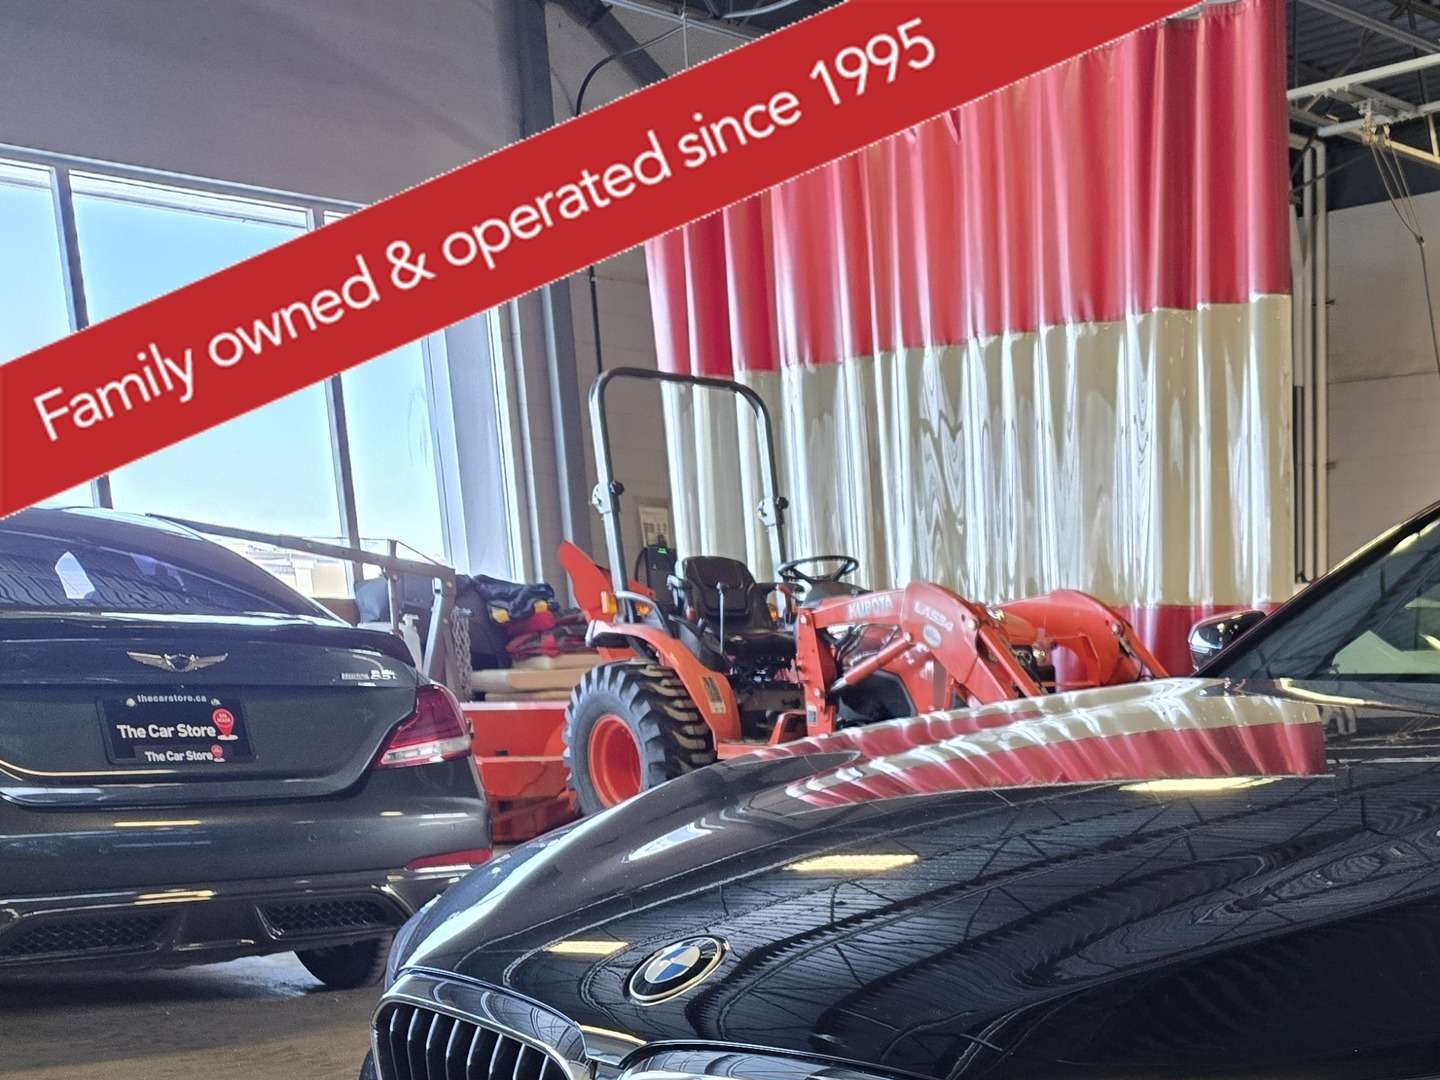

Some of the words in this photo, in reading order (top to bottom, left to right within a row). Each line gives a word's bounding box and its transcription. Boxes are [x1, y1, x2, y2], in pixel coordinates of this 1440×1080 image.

[137, 694, 207, 703] thecarstore.ca
[116, 724, 147, 739] The
[148, 724, 175, 738] Car
[176, 723, 217, 738] Store
[145, 751, 166, 762] The
[166, 750, 185, 761] Car
[187, 750, 213, 761] Store
